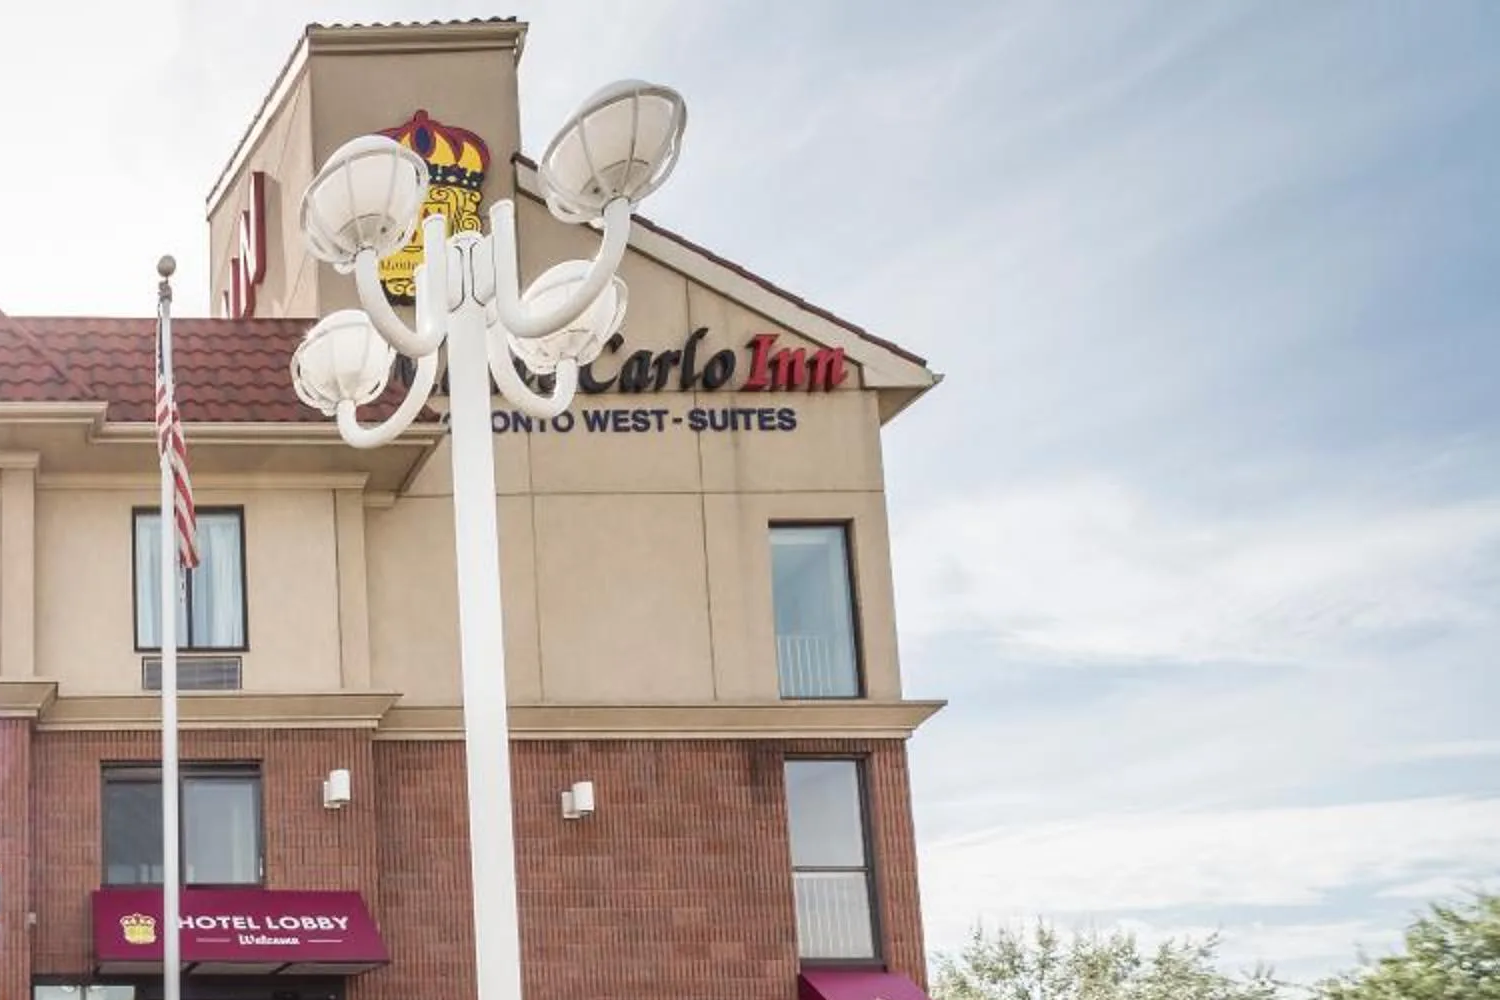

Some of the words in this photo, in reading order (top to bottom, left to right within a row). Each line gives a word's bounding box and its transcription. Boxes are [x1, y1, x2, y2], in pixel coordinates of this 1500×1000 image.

[578, 327, 735, 394] Carlo
[740, 333, 848, 393] Inn
[442, 409, 574, 433] ONTO
[178, 915, 261, 931] HOTEL
[265, 915, 349, 931] LOBBY
